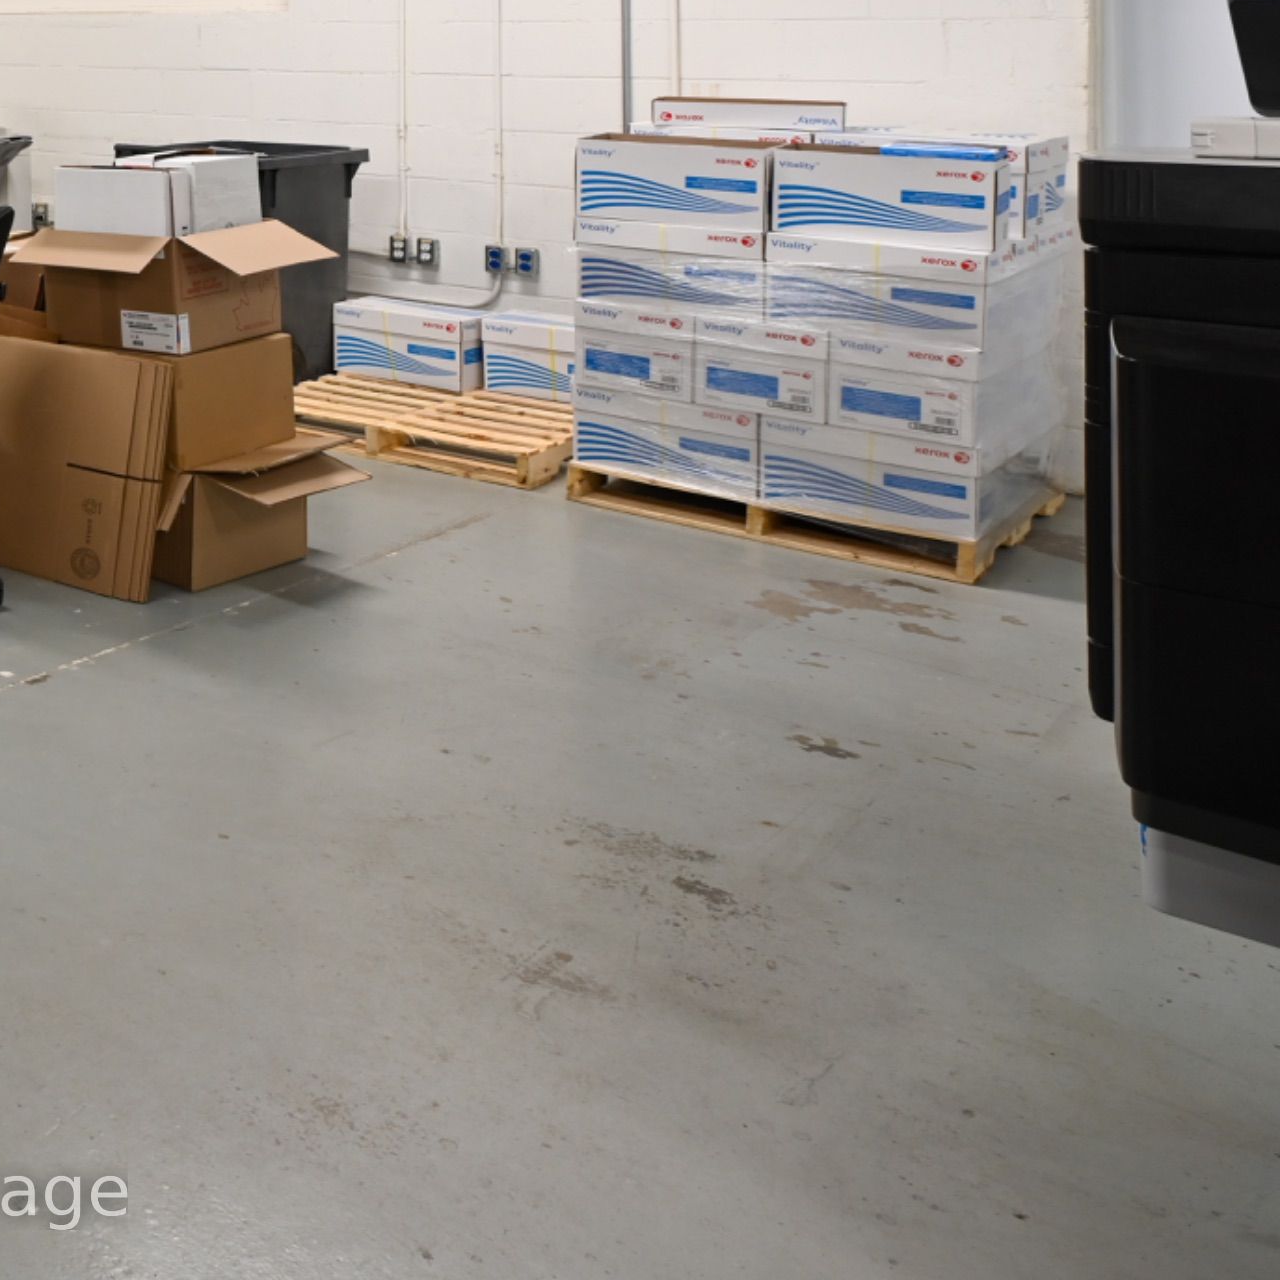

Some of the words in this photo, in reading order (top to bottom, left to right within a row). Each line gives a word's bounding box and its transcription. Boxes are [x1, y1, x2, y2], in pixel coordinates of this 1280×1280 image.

[778, 159, 815, 171] Vitality
[936, 170, 967, 180] xerox
[580, 222, 616, 234] Vitality
[707, 234, 738, 244] xerox
[771, 237, 813, 252] Vitality
[921, 255, 958, 267] xerox
